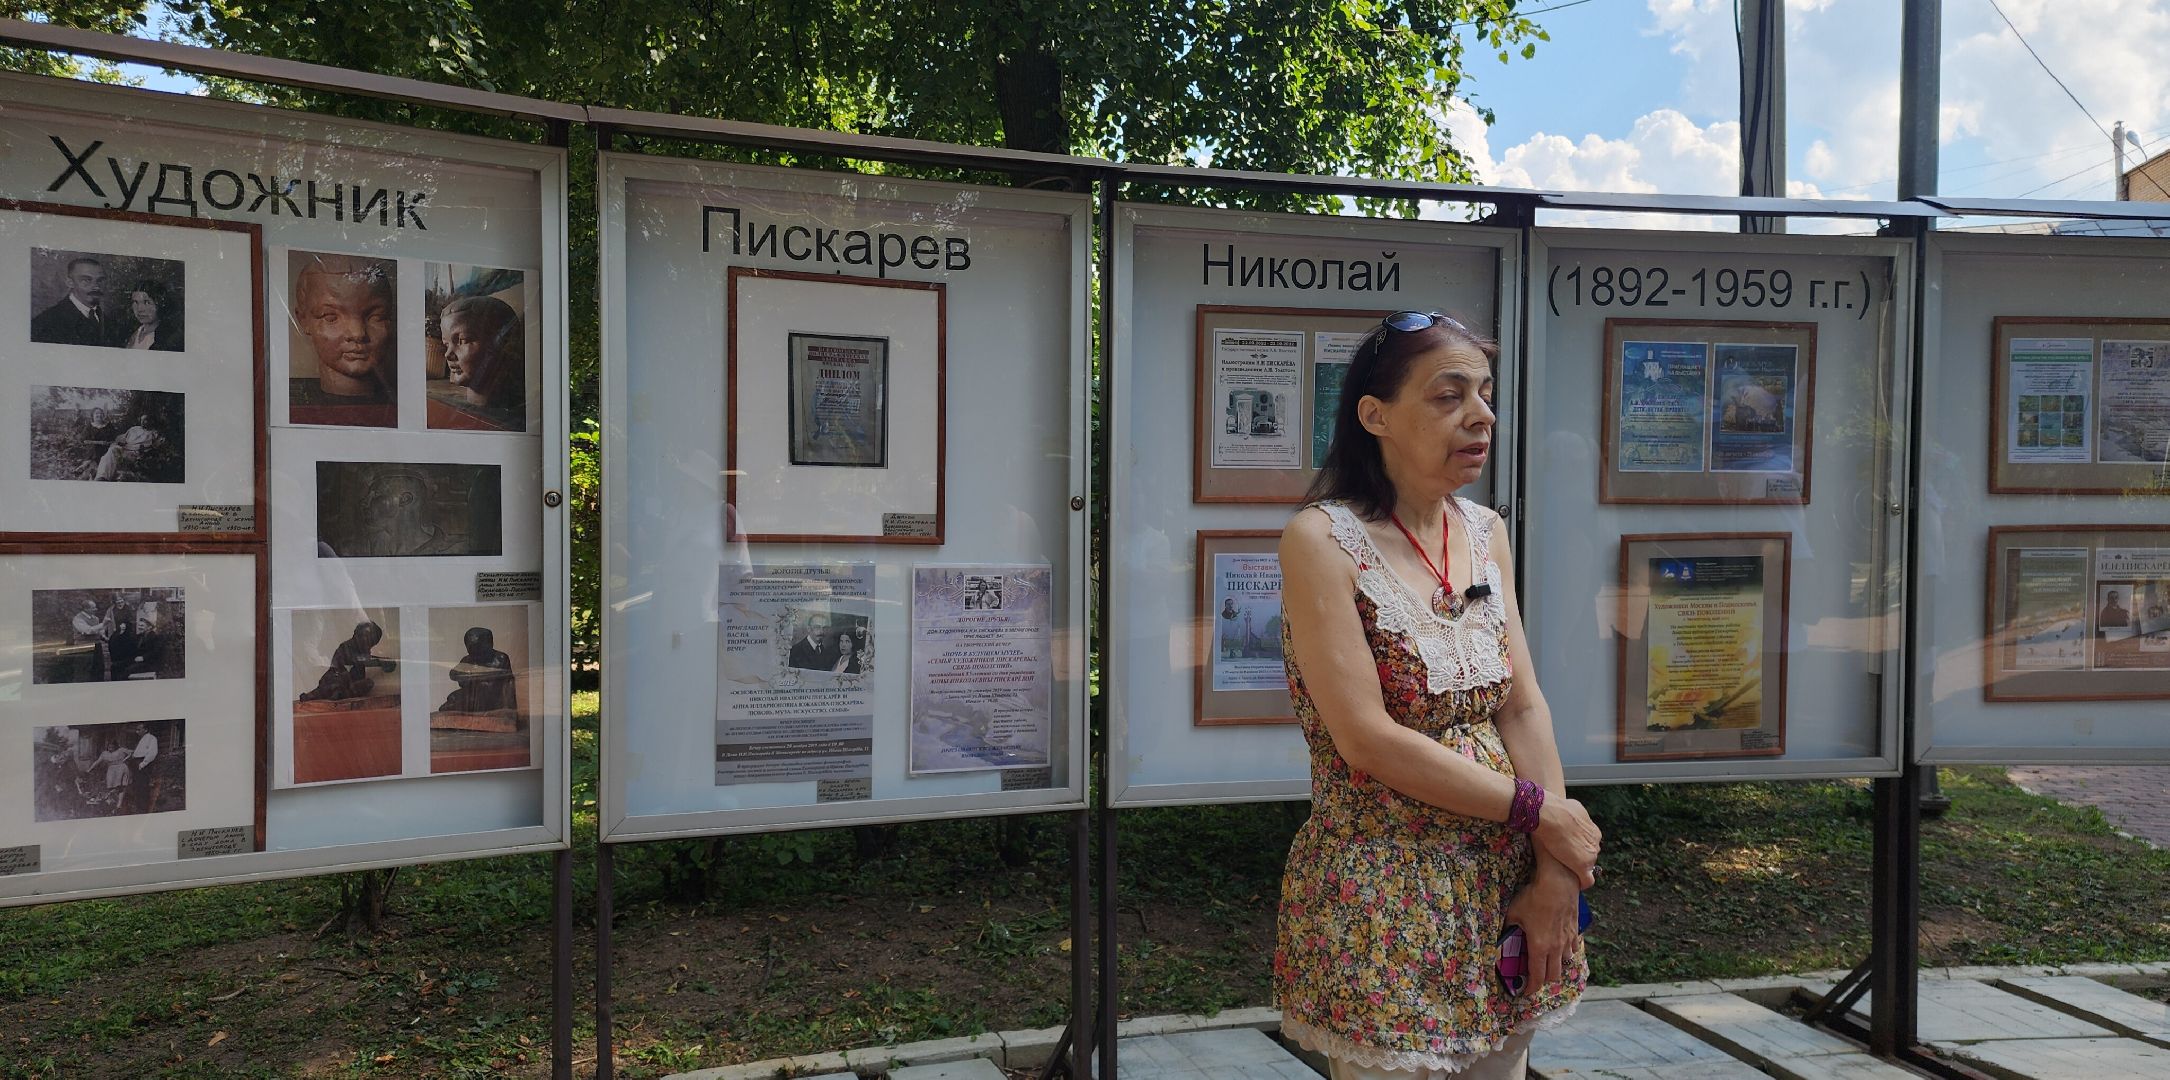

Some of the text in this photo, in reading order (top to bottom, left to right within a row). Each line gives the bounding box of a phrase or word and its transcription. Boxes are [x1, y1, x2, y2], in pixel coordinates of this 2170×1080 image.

[47, 135, 427, 231] Художник
[702, 205, 972, 278] Пискарев
[1203, 243, 1400, 292] Николай
[1548, 264, 1872, 320] (1892-1959 г.г.)
[1225, 571, 1258, 579] Николай
[1242, 563, 1277, 571] Выставка
